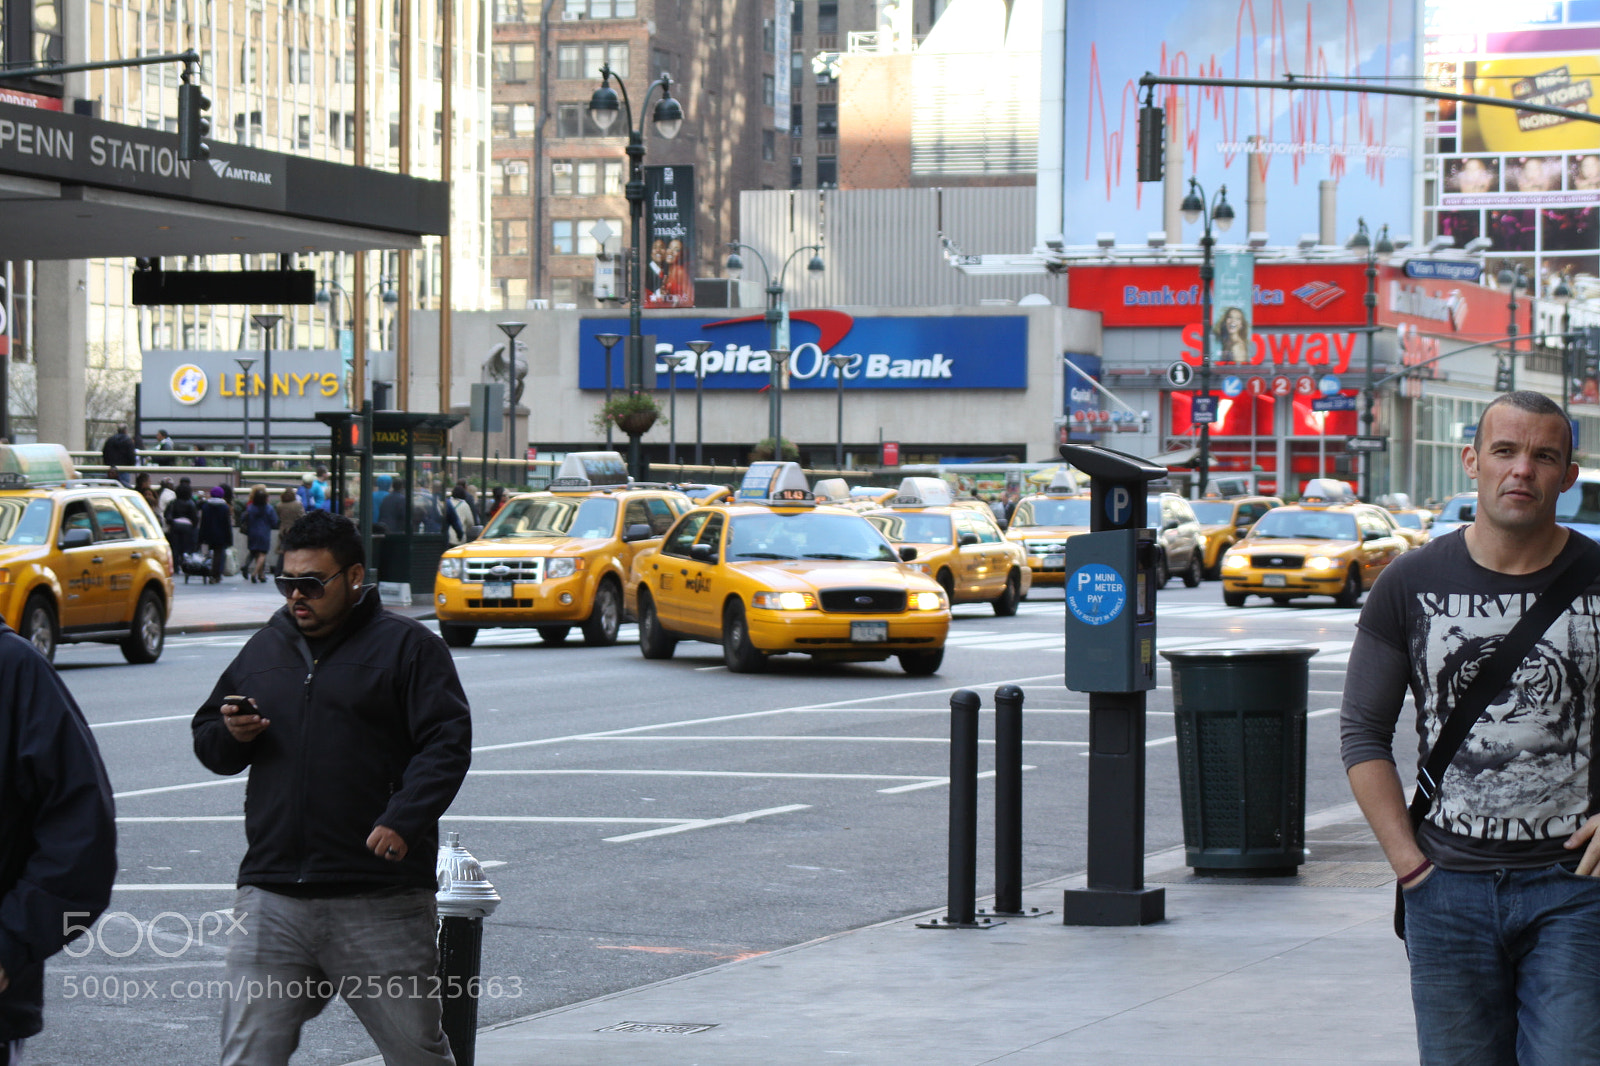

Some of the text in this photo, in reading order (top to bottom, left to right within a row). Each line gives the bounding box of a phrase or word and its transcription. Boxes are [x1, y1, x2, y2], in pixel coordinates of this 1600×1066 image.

[1546, 81, 1590, 105] YORK
[0, 119, 190, 180] PENN STATION
[225, 166, 272, 185] AMTRAK
[653, 191, 678, 207] find
[653, 212, 680, 224] your
[654, 223, 688, 238] magic
[1123, 286, 1176, 305] Bank
[1177, 285, 1199, 304] of
[655, 342, 953, 379] Capita One Bank
[219, 373, 340, 396] LENNY'S
[1252, 379, 1260, 392] 1
[1275, 379, 1287, 392] 2
[1299, 378, 1310, 392] 3
[375, 432, 400, 442] TAXI
[783, 490, 804, 500] 1L43
[1113, 487, 1129, 522] P
[1078, 573, 1116, 591] P MUNI
[1094, 583, 1123, 592] METER
[1087, 594, 1103, 603] PAY
